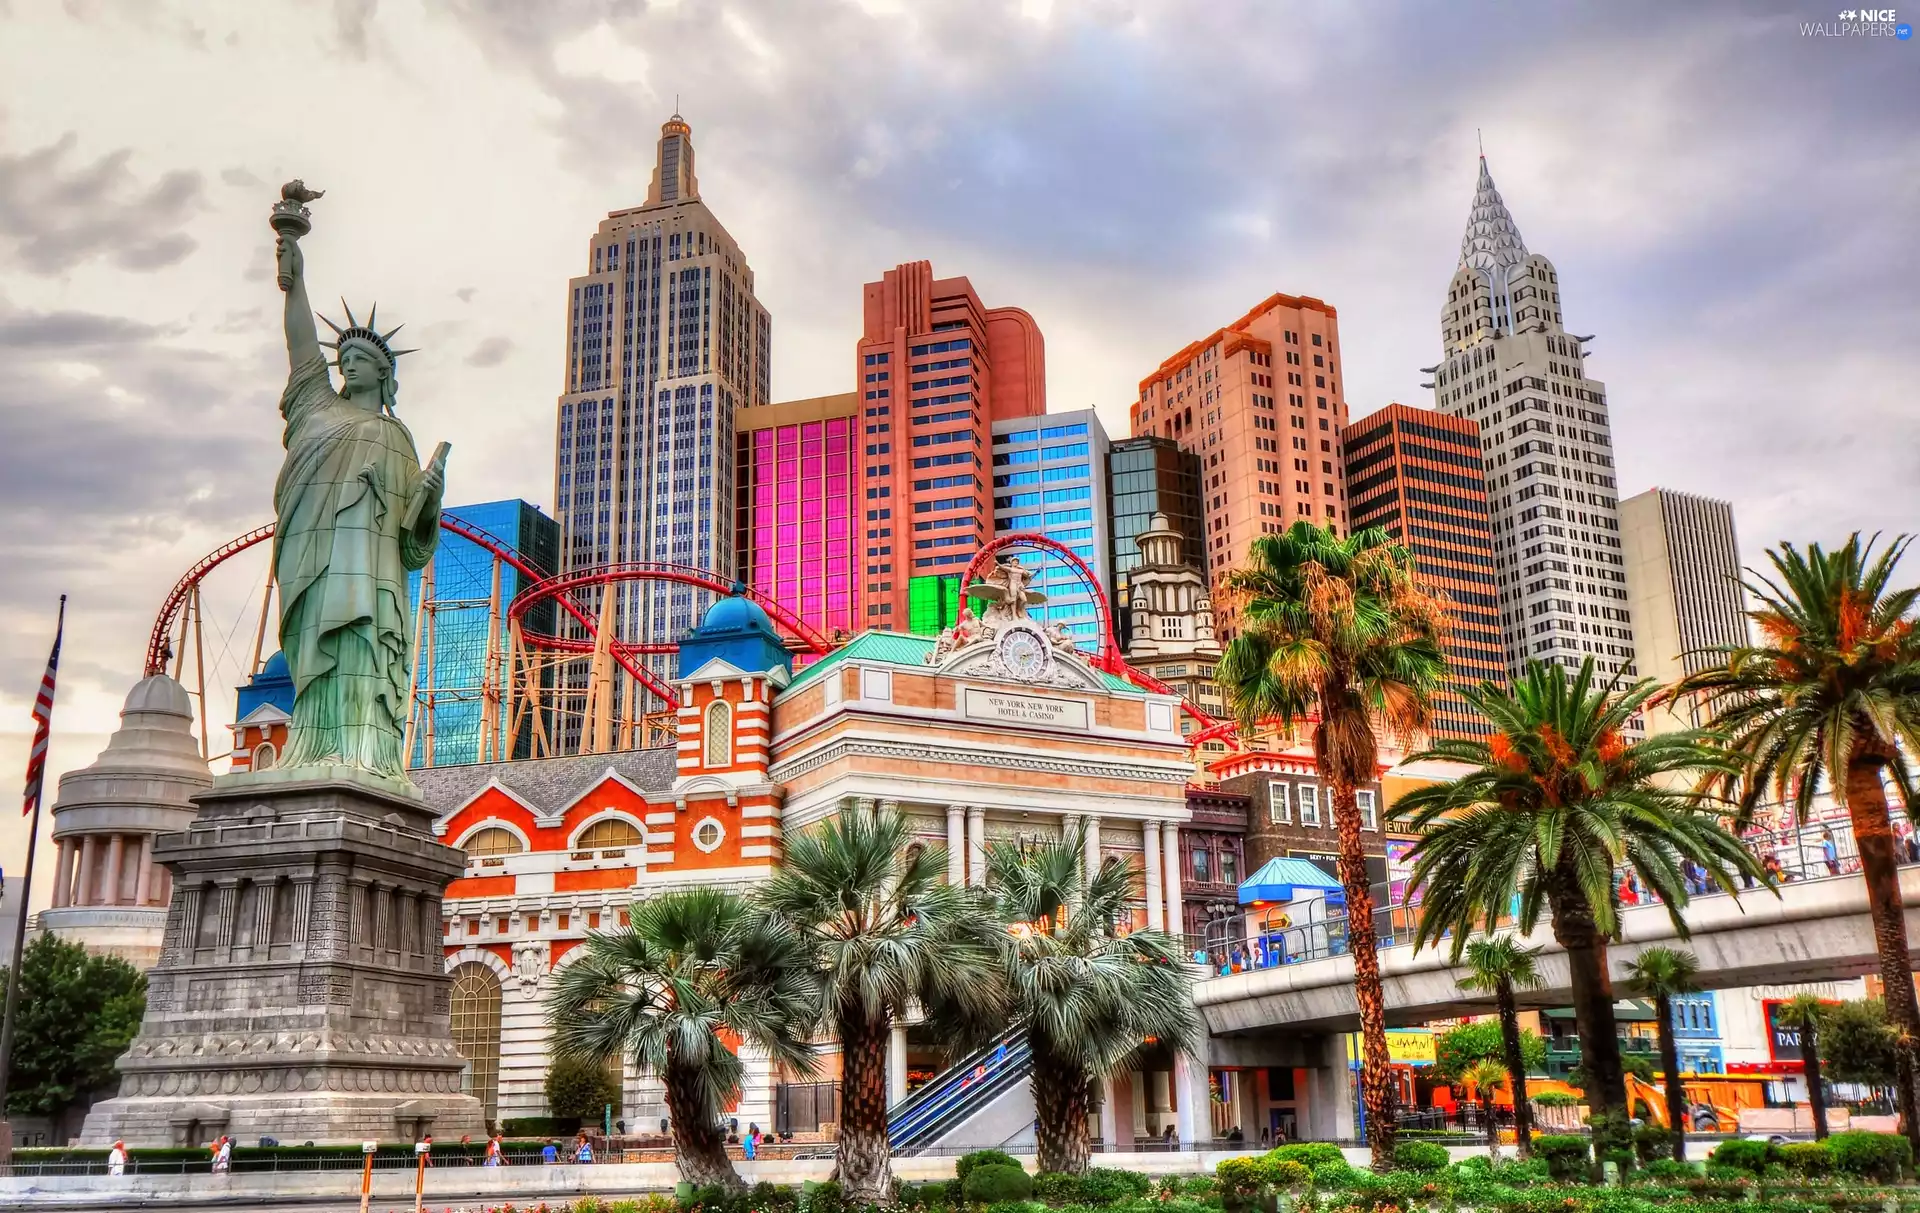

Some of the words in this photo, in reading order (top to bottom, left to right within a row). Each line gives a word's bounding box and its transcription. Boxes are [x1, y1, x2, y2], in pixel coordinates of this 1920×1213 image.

[989, 698, 1004, 706] NEW
[1006, 700, 1026, 709] YORK
[1028, 702, 1043, 711] NEW
[1046, 704, 1064, 713] YORK
[998, 708, 1020, 717] HOTEL
[1029, 711, 1055, 720] CASINO
